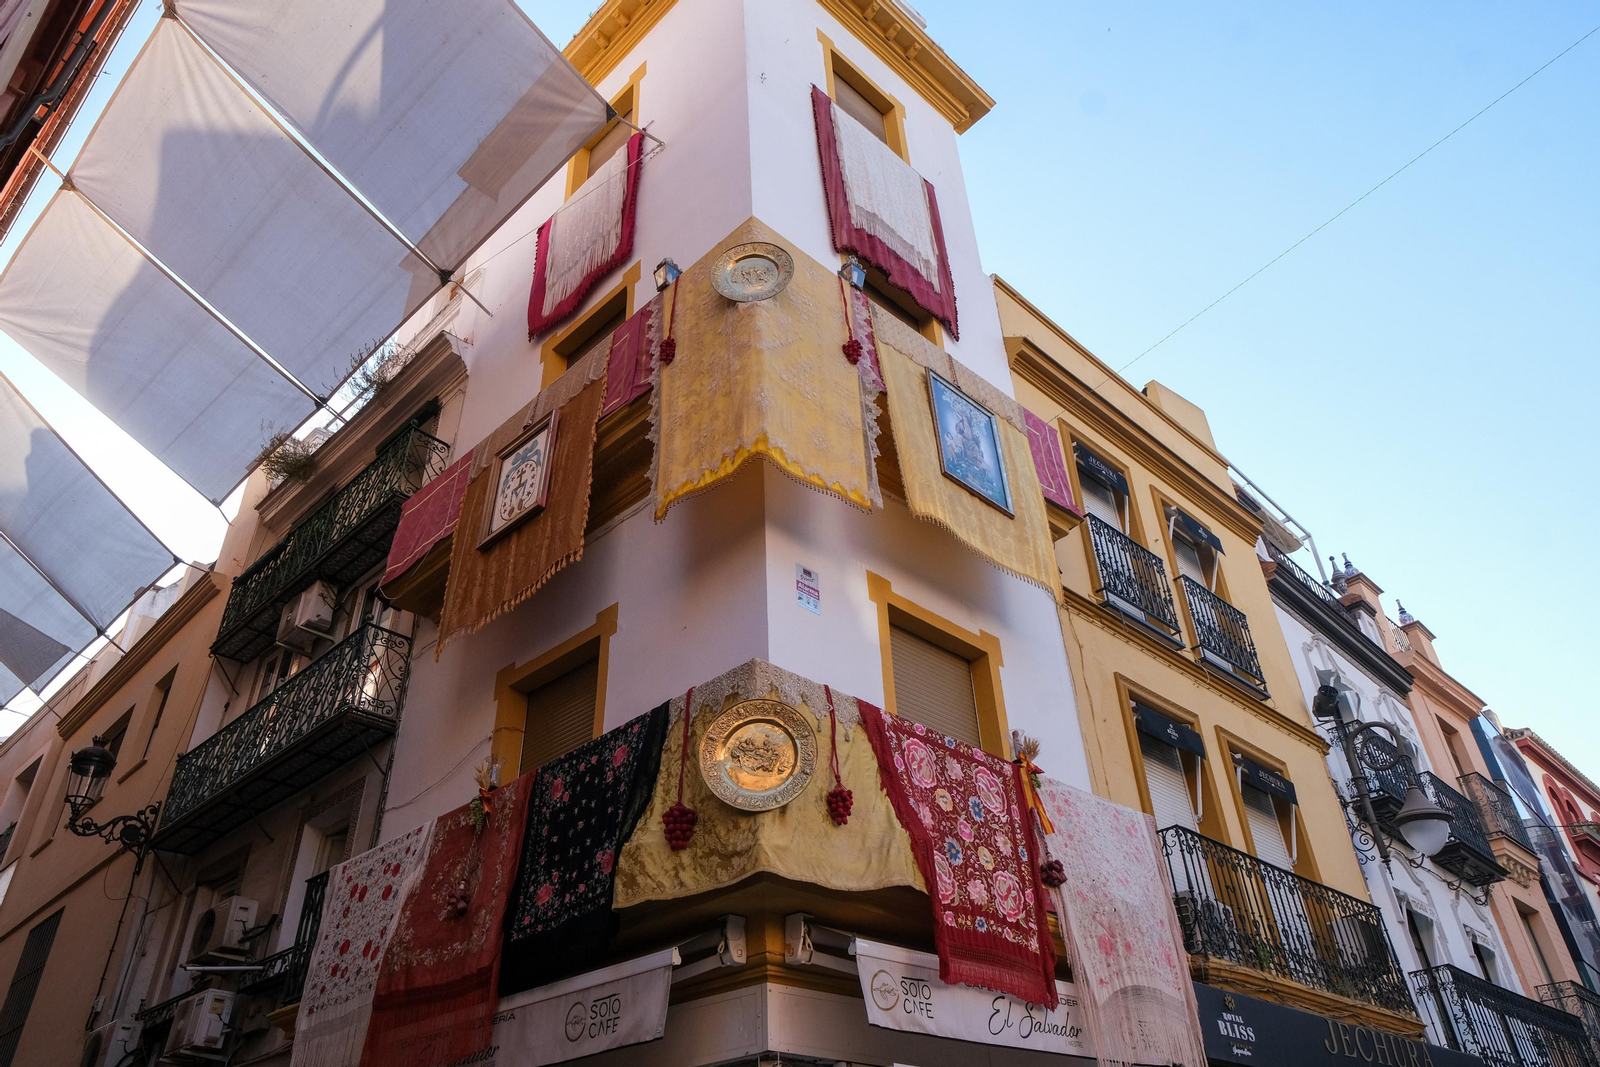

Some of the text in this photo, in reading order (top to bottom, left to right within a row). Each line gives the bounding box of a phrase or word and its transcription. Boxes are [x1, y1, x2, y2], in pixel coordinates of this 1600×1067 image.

[900, 976, 931, 1000] SOTO
[590, 993, 620, 1020] SOTO
[904, 998, 934, 1019] CAFE
[988, 995, 1083, 1039] El Salvador
[1222, 1012, 1244, 1024] ROYAL
[588, 1017, 620, 1038] CAFE
[1217, 1020, 1256, 1042] BLISS
[1324, 1018, 1434, 1067] JECHURA
